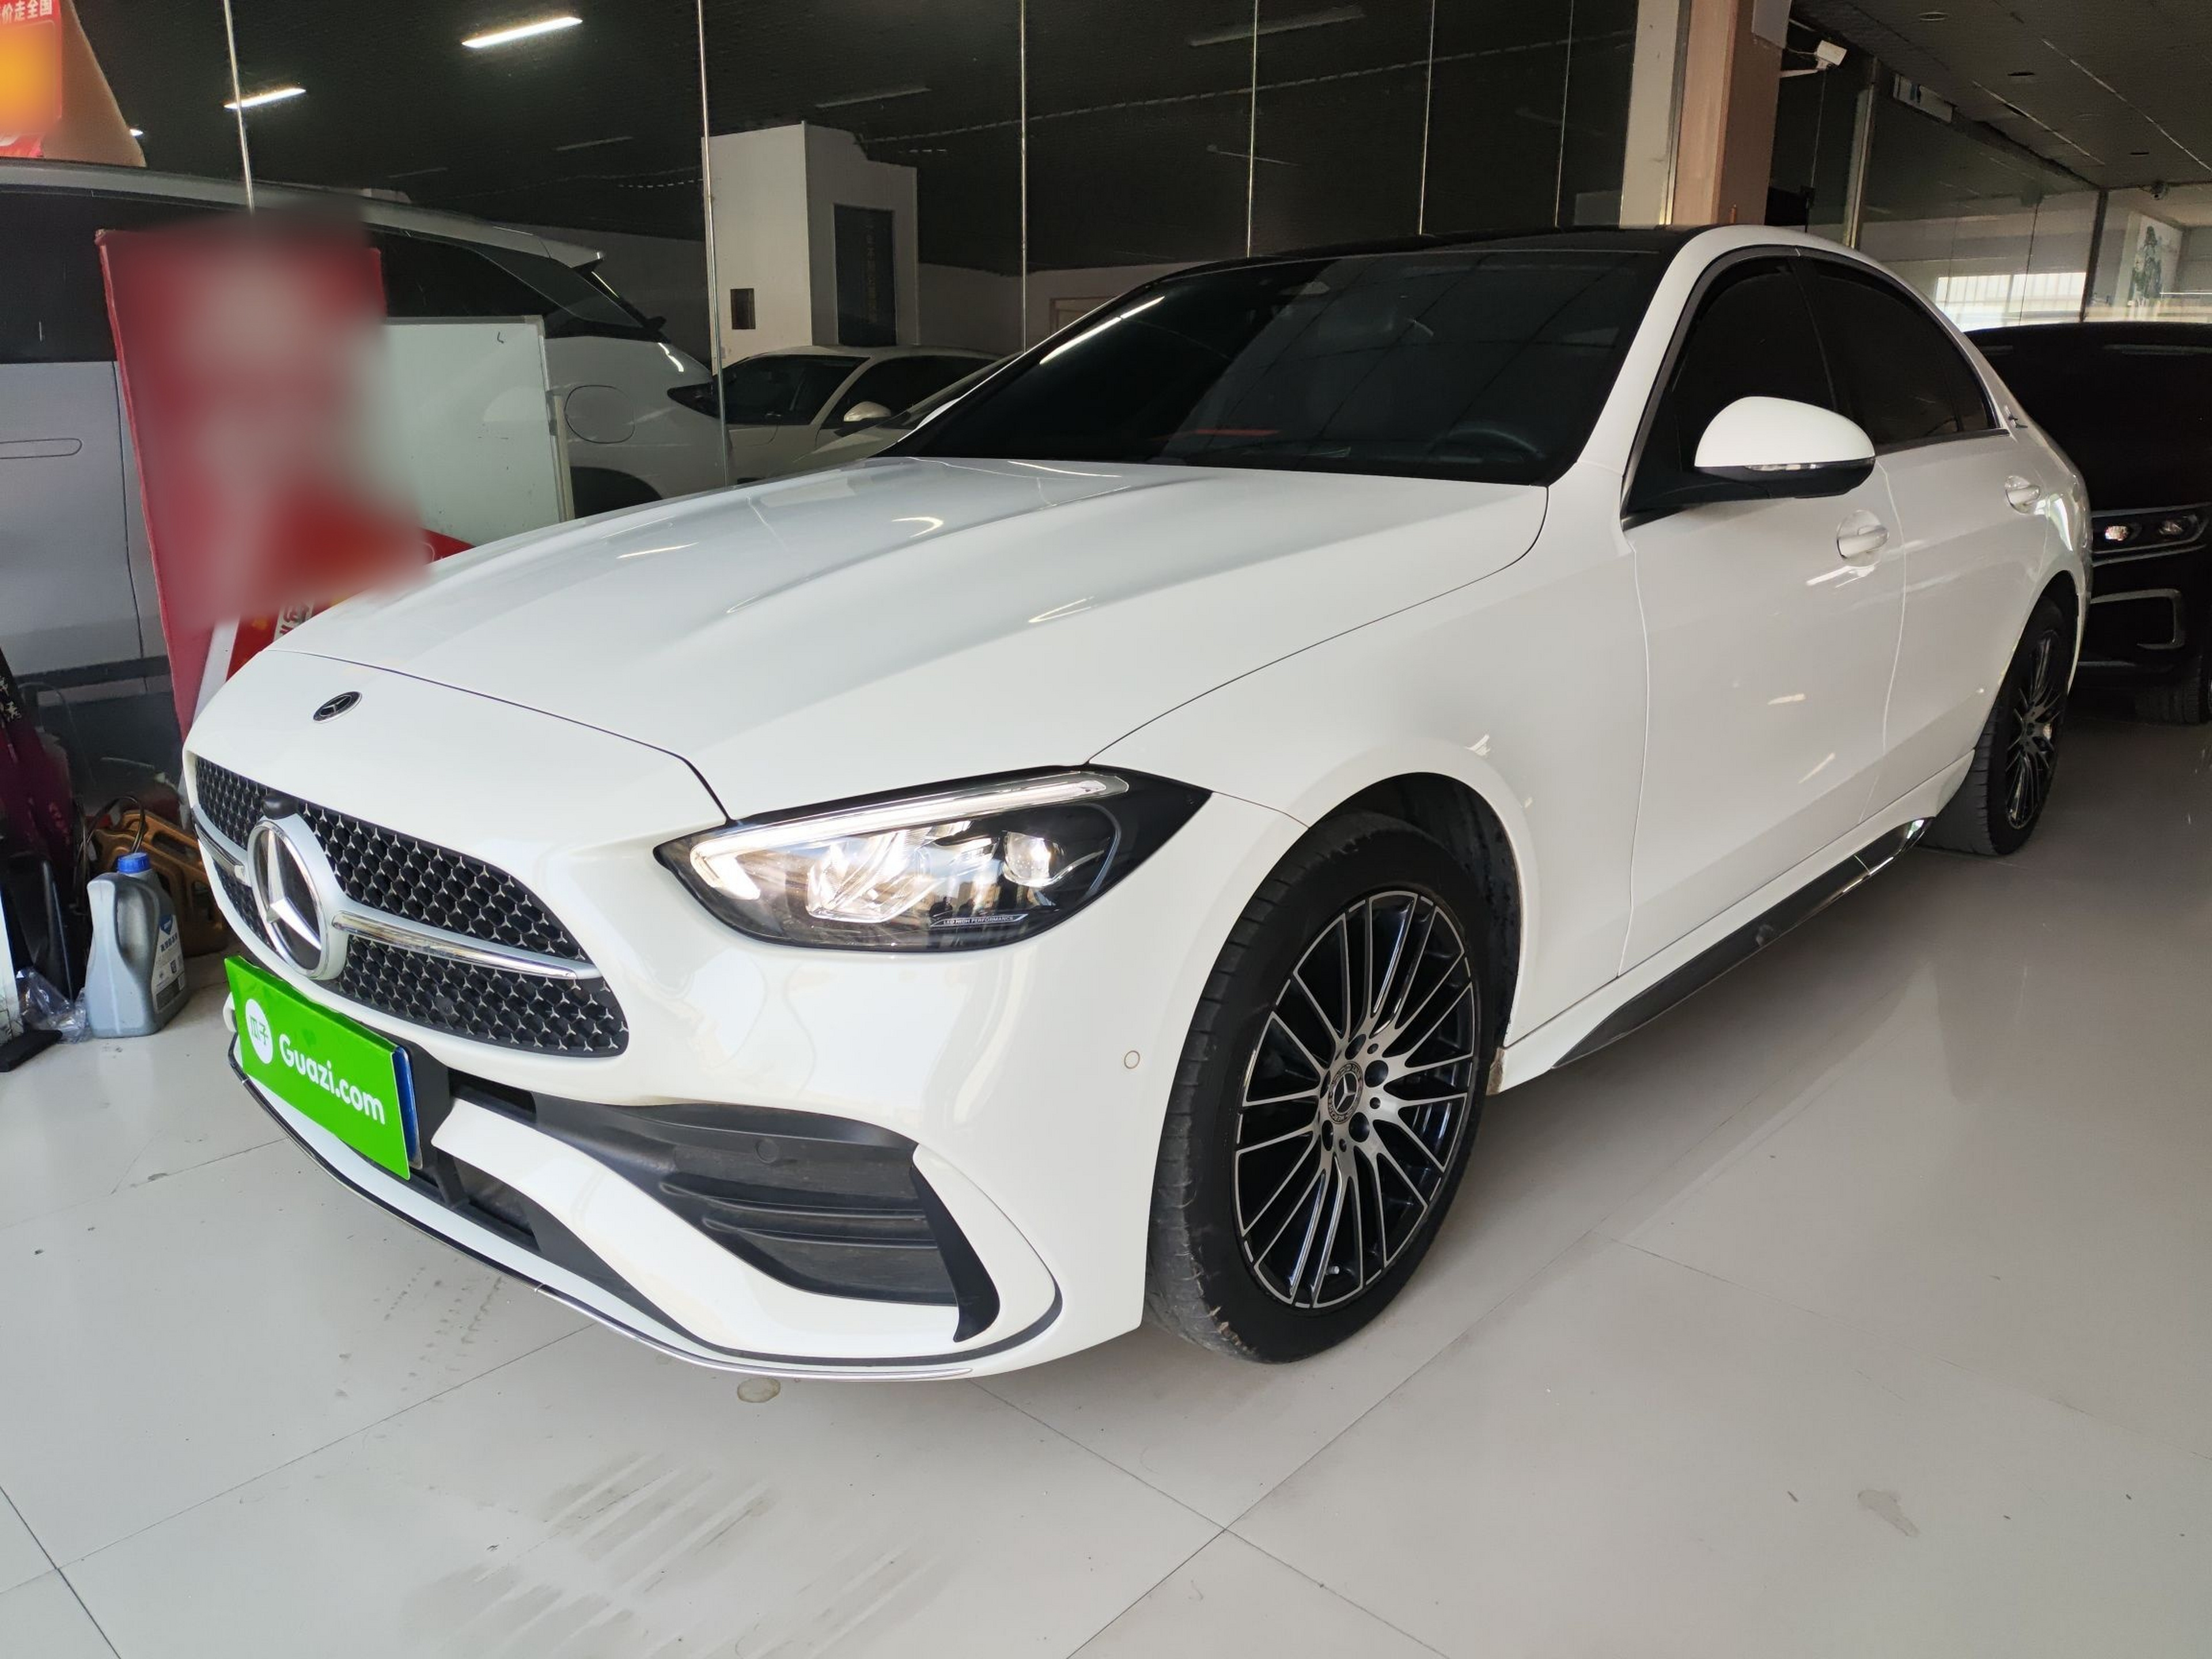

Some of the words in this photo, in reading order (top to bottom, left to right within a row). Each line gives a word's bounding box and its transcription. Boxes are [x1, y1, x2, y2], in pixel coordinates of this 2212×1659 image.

[0, 0, 52, 23] 价走全国
[971, 915, 1014, 923] PERFORMANCE
[249, 1016, 268, 1046] 瓜子
[279, 1034, 385, 1125] Guazi.com
